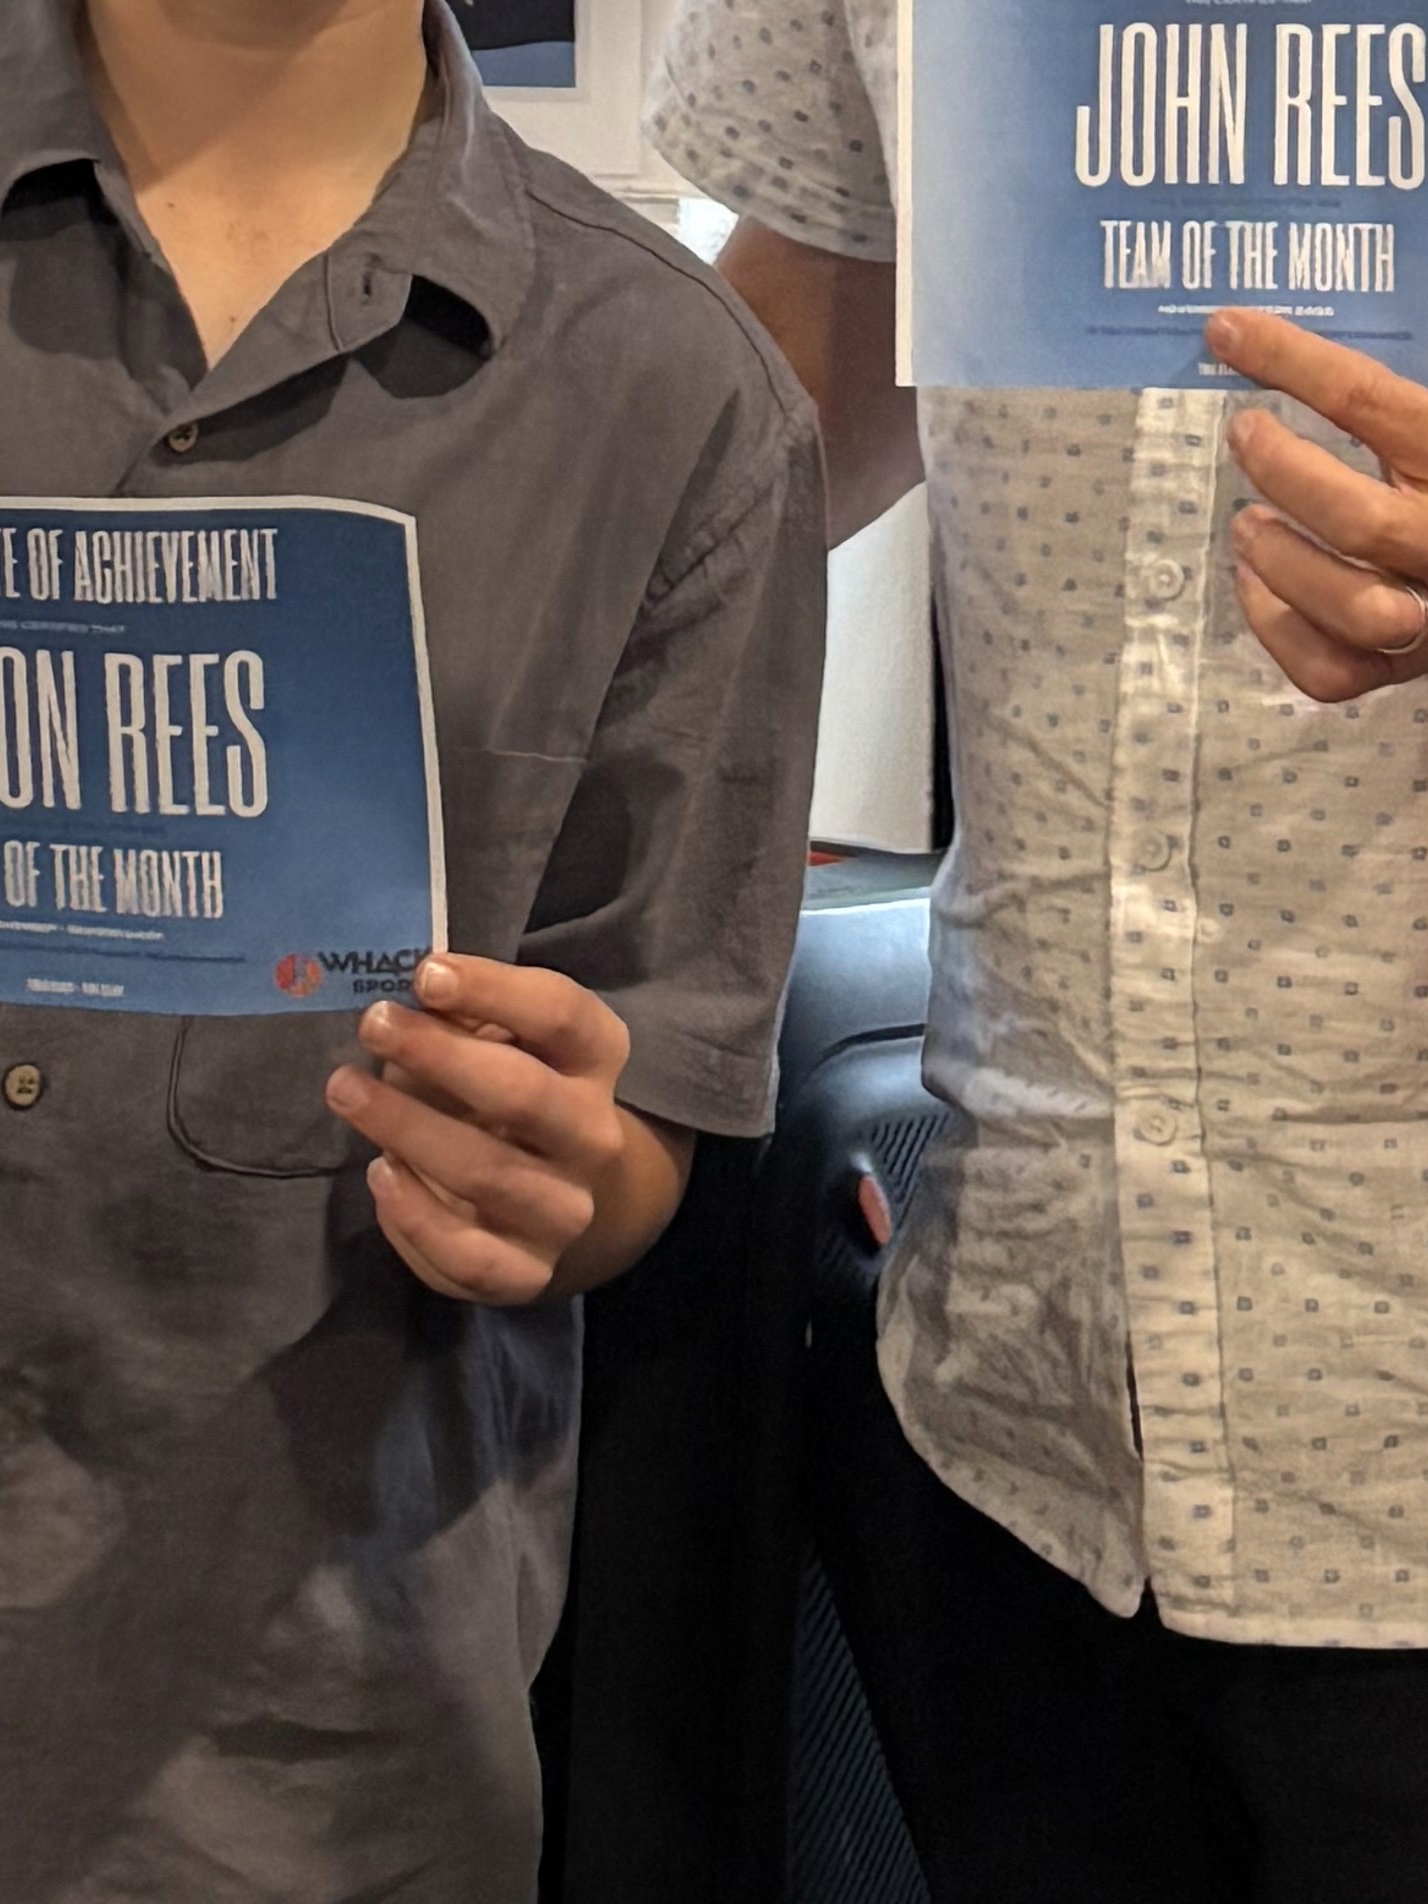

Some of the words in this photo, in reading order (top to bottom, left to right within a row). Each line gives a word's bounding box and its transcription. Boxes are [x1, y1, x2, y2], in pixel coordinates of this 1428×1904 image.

[1075, 22, 1246, 188] JOHN
[1274, 22, 1426, 190] REES
[1100, 220, 1171, 290] TEAM
[1182, 220, 1217, 289] OF
[1225, 221, 1277, 291] THE
[1289, 222, 1395, 293] MONTH
[28, 527, 64, 601] OF
[75, 528, 278, 605] ACHIEVEMENT
[106, 650, 269, 819] REES
[4, 840, 41, 908] OF
[50, 844, 108, 914] THE
[114, 849, 225, 920] MONTH
